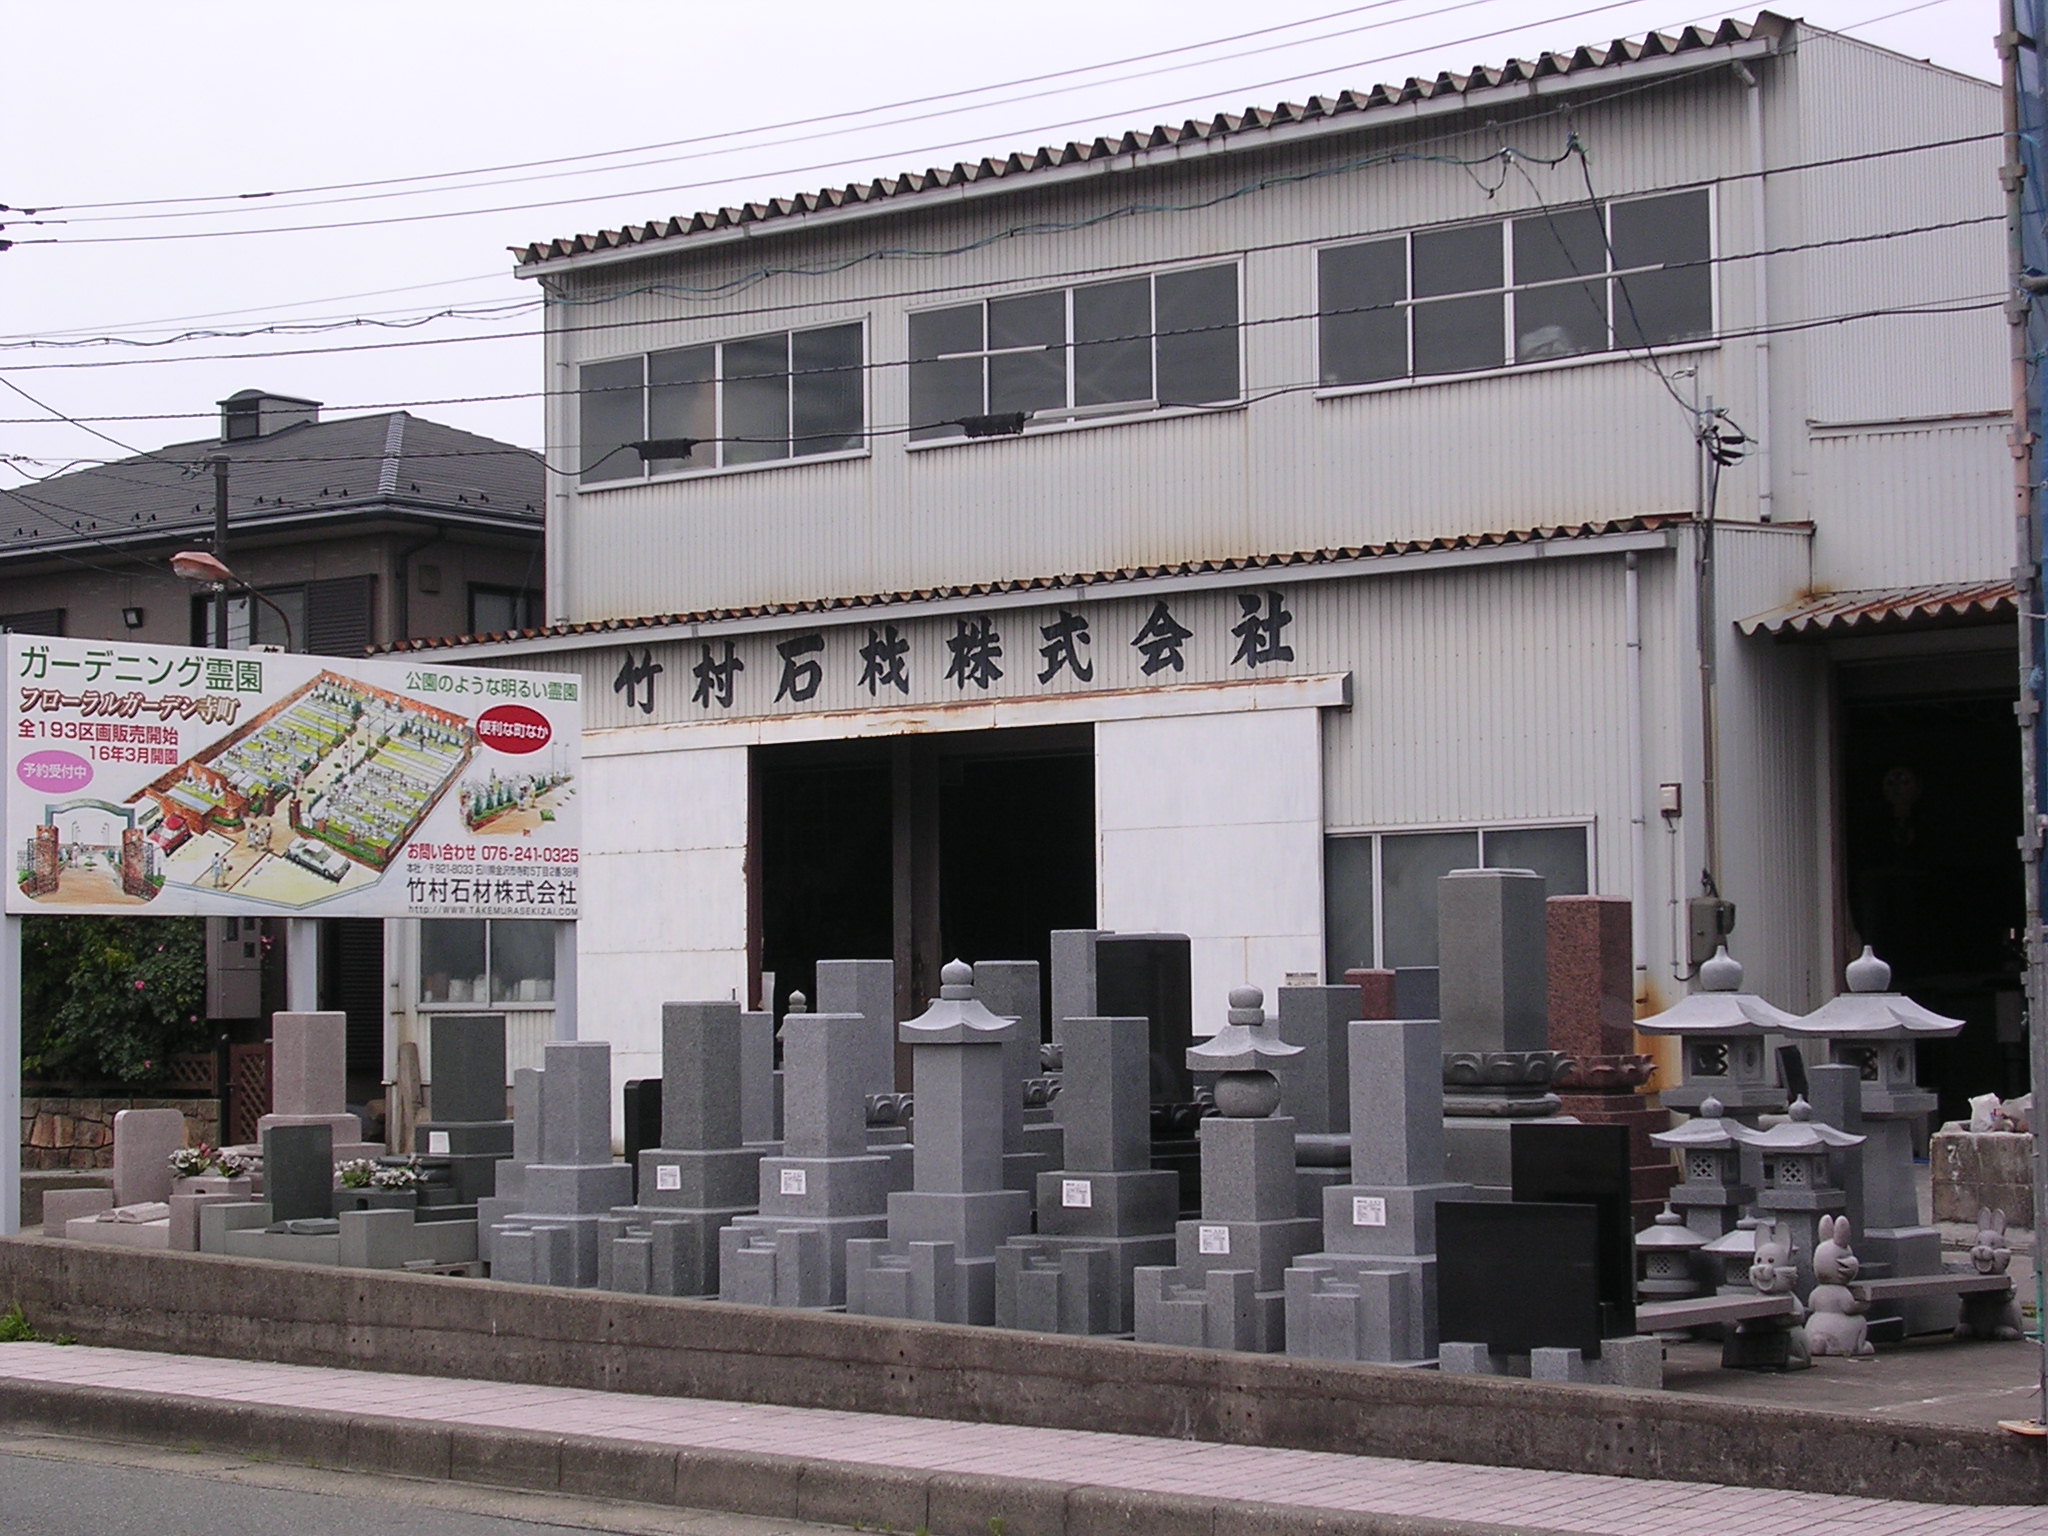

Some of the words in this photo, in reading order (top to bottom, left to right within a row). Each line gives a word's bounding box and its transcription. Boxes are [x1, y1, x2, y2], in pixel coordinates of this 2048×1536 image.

[19, 646, 263, 694] ガーデニング霊園
[406, 671, 578, 702] 公園のような明るい霊園
[21, 687, 240, 725] フローラルガーデン寺町
[18, 718, 179, 746] 全193区画販売開始
[478, 719, 549, 740] 便利な町なか
[89, 745, 178, 765] 16年3月開園
[23, 762, 87, 781] 予約受付中
[407, 843, 476, 862] お問い合わせ
[482, 845, 579, 863] 076-241-0325
[406, 877, 577, 905] 竹村石材株式会社
